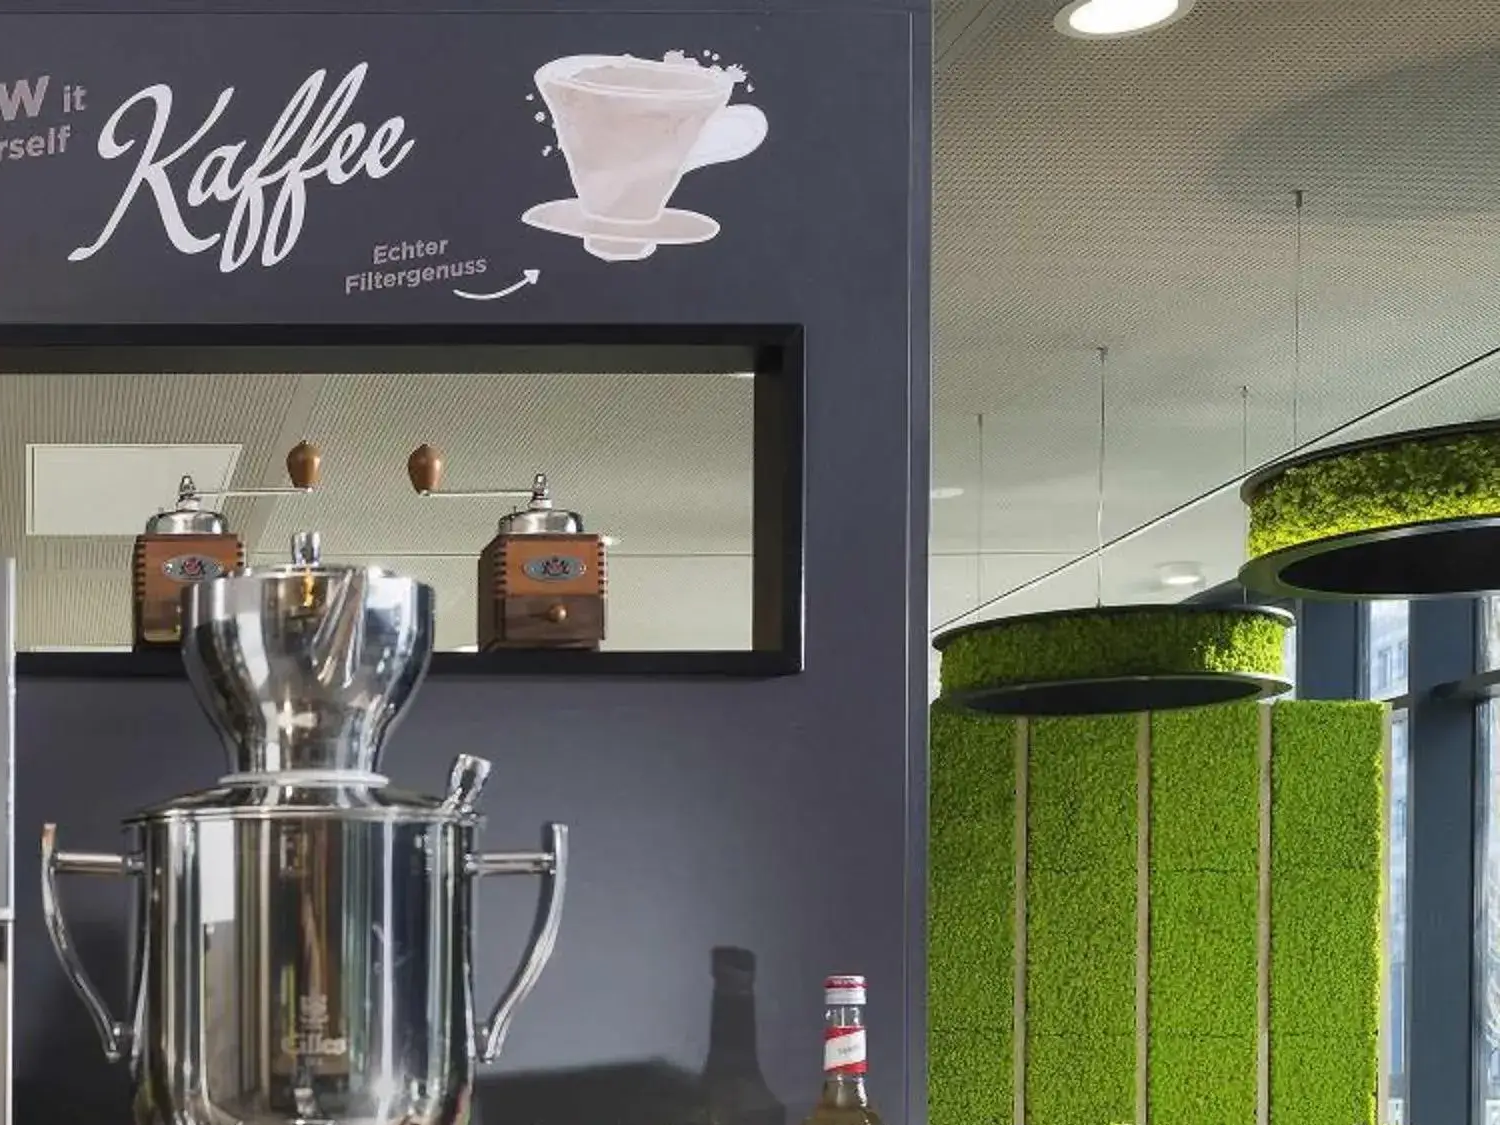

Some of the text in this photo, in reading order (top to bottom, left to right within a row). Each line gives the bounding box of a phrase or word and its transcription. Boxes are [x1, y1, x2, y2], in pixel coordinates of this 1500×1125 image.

[63, 84, 87, 113] it
[67, 62, 415, 273] Kaffee
[372, 239, 450, 266] Echter
[345, 258, 488, 296] Filtergenuss
